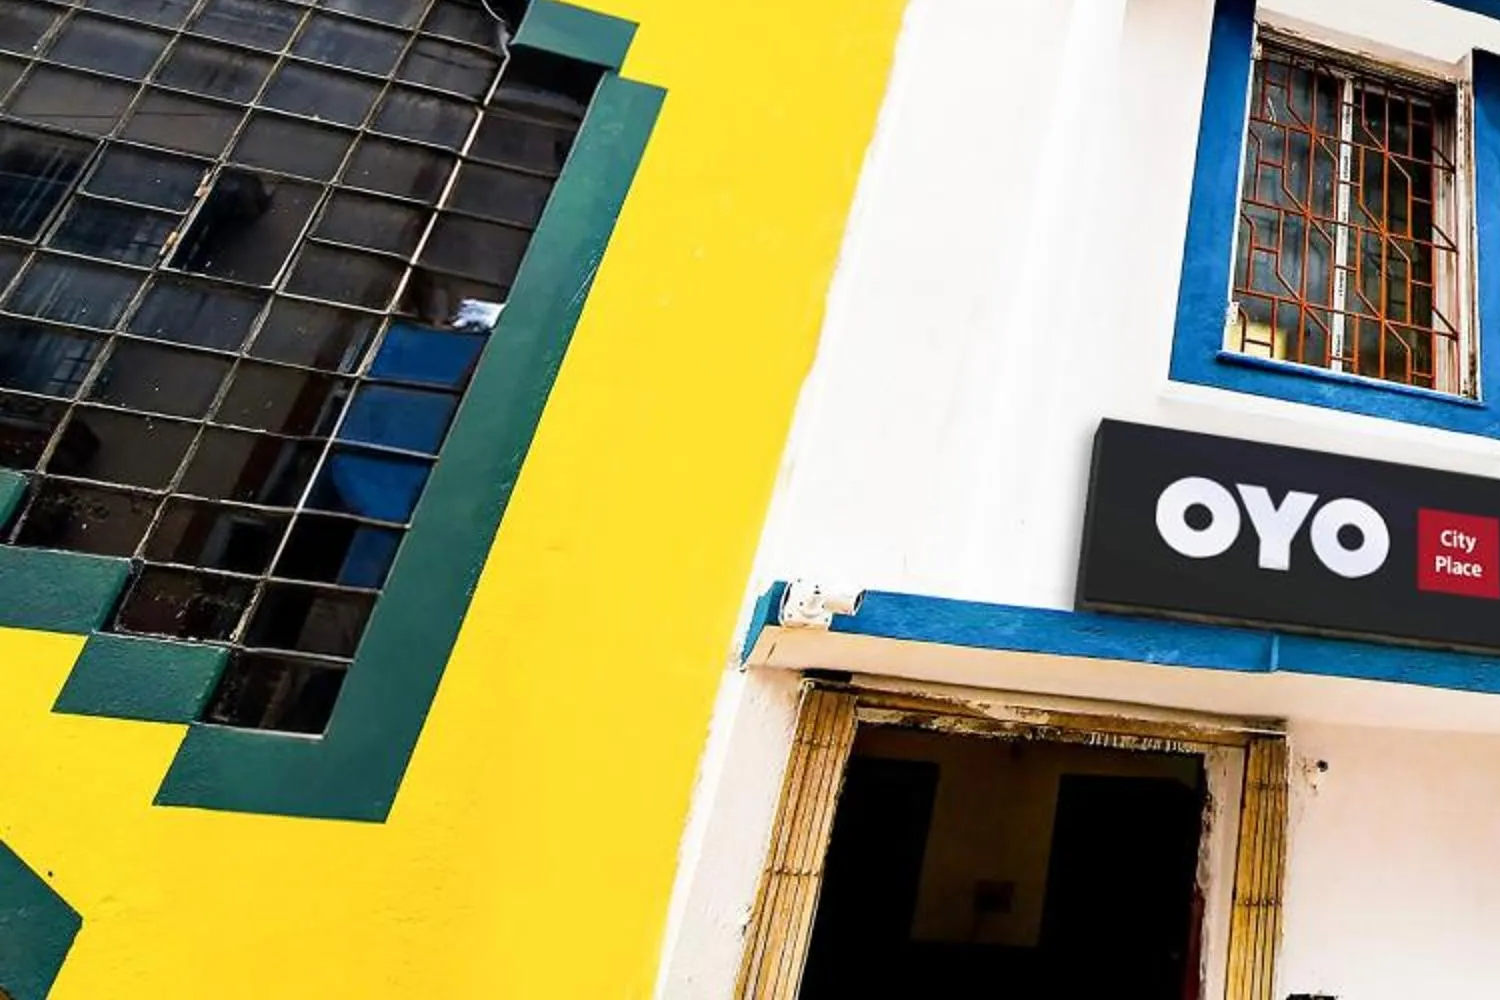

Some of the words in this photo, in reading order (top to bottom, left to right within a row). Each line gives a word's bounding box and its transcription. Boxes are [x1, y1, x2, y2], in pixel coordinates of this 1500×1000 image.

[1155, 476, 1391, 579] OYO
[1440, 529, 1477, 554] City
[1435, 555, 1483, 578] Place
